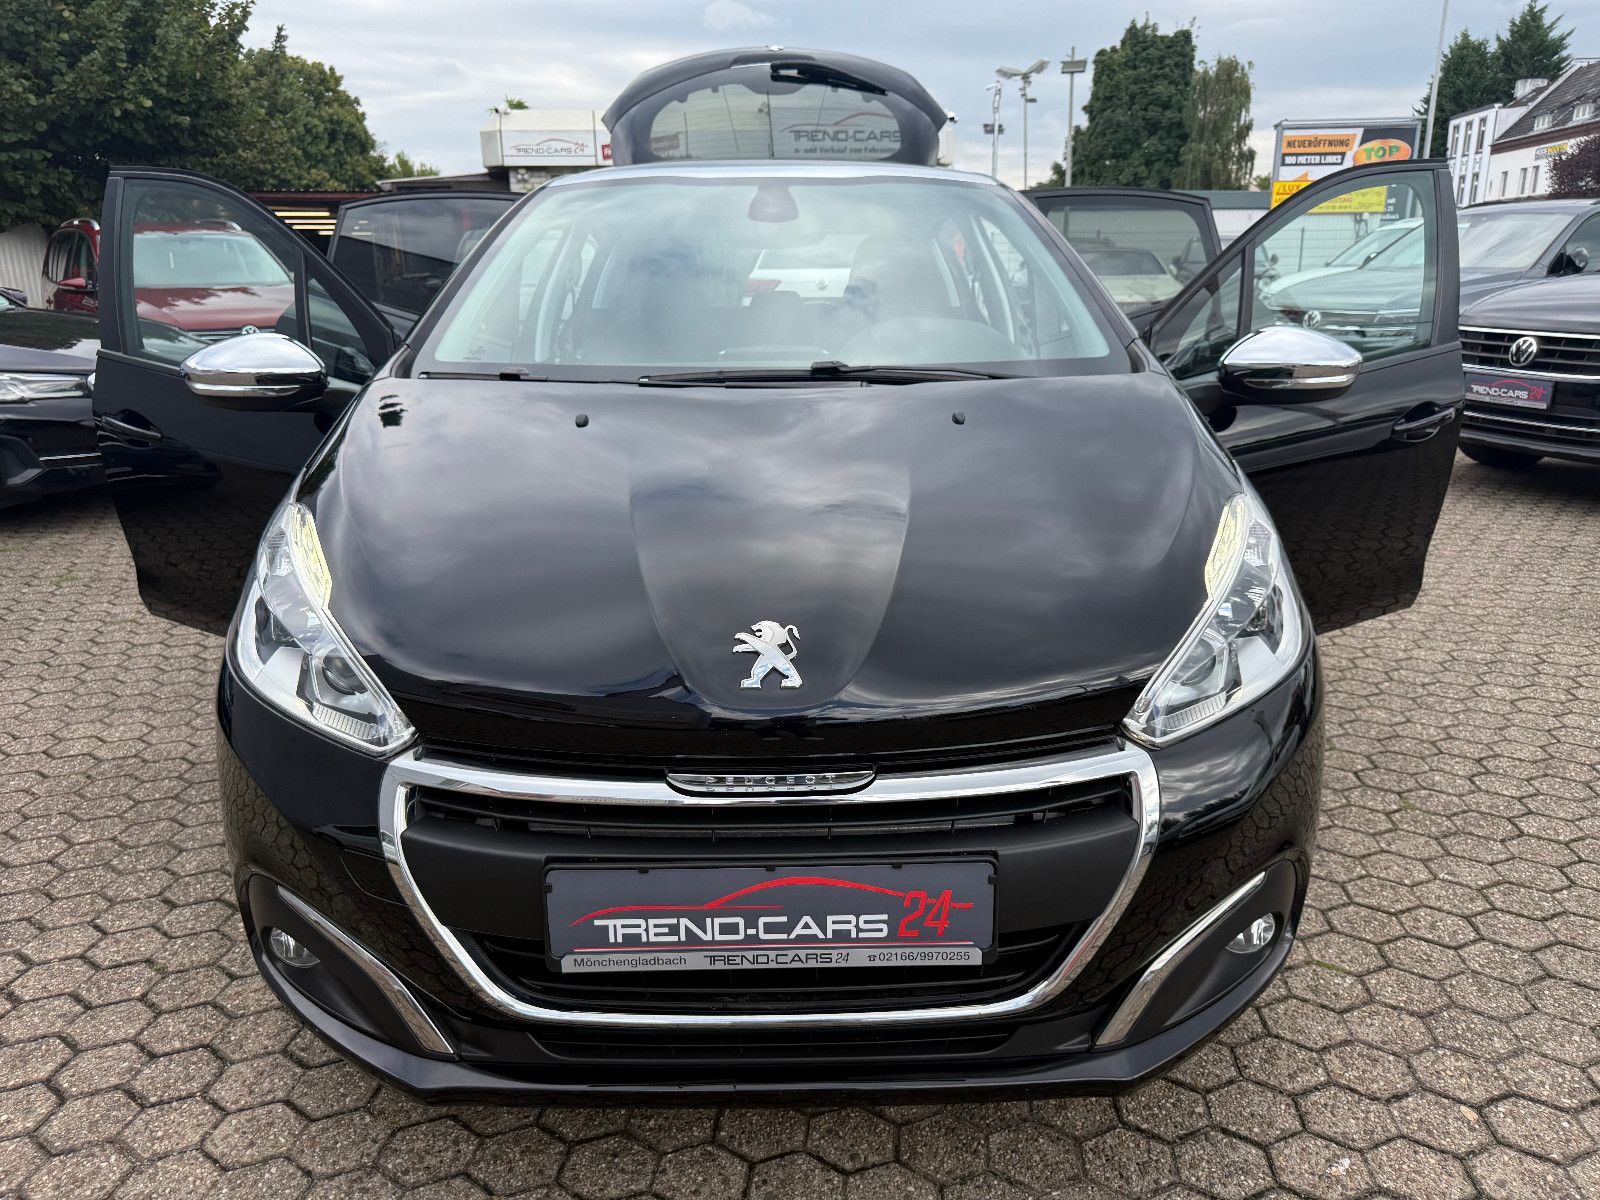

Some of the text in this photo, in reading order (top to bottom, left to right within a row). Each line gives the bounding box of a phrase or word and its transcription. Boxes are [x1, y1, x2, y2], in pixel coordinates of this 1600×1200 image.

[1287, 137, 1350, 148] NEUERÖFFNUNG
[1363, 145, 1400, 161] TOP
[594, 889, 954, 943] TREND-CARS 24
[573, 951, 970, 968] Mönchengladbach TREND-CARS 24 02166/9970255
